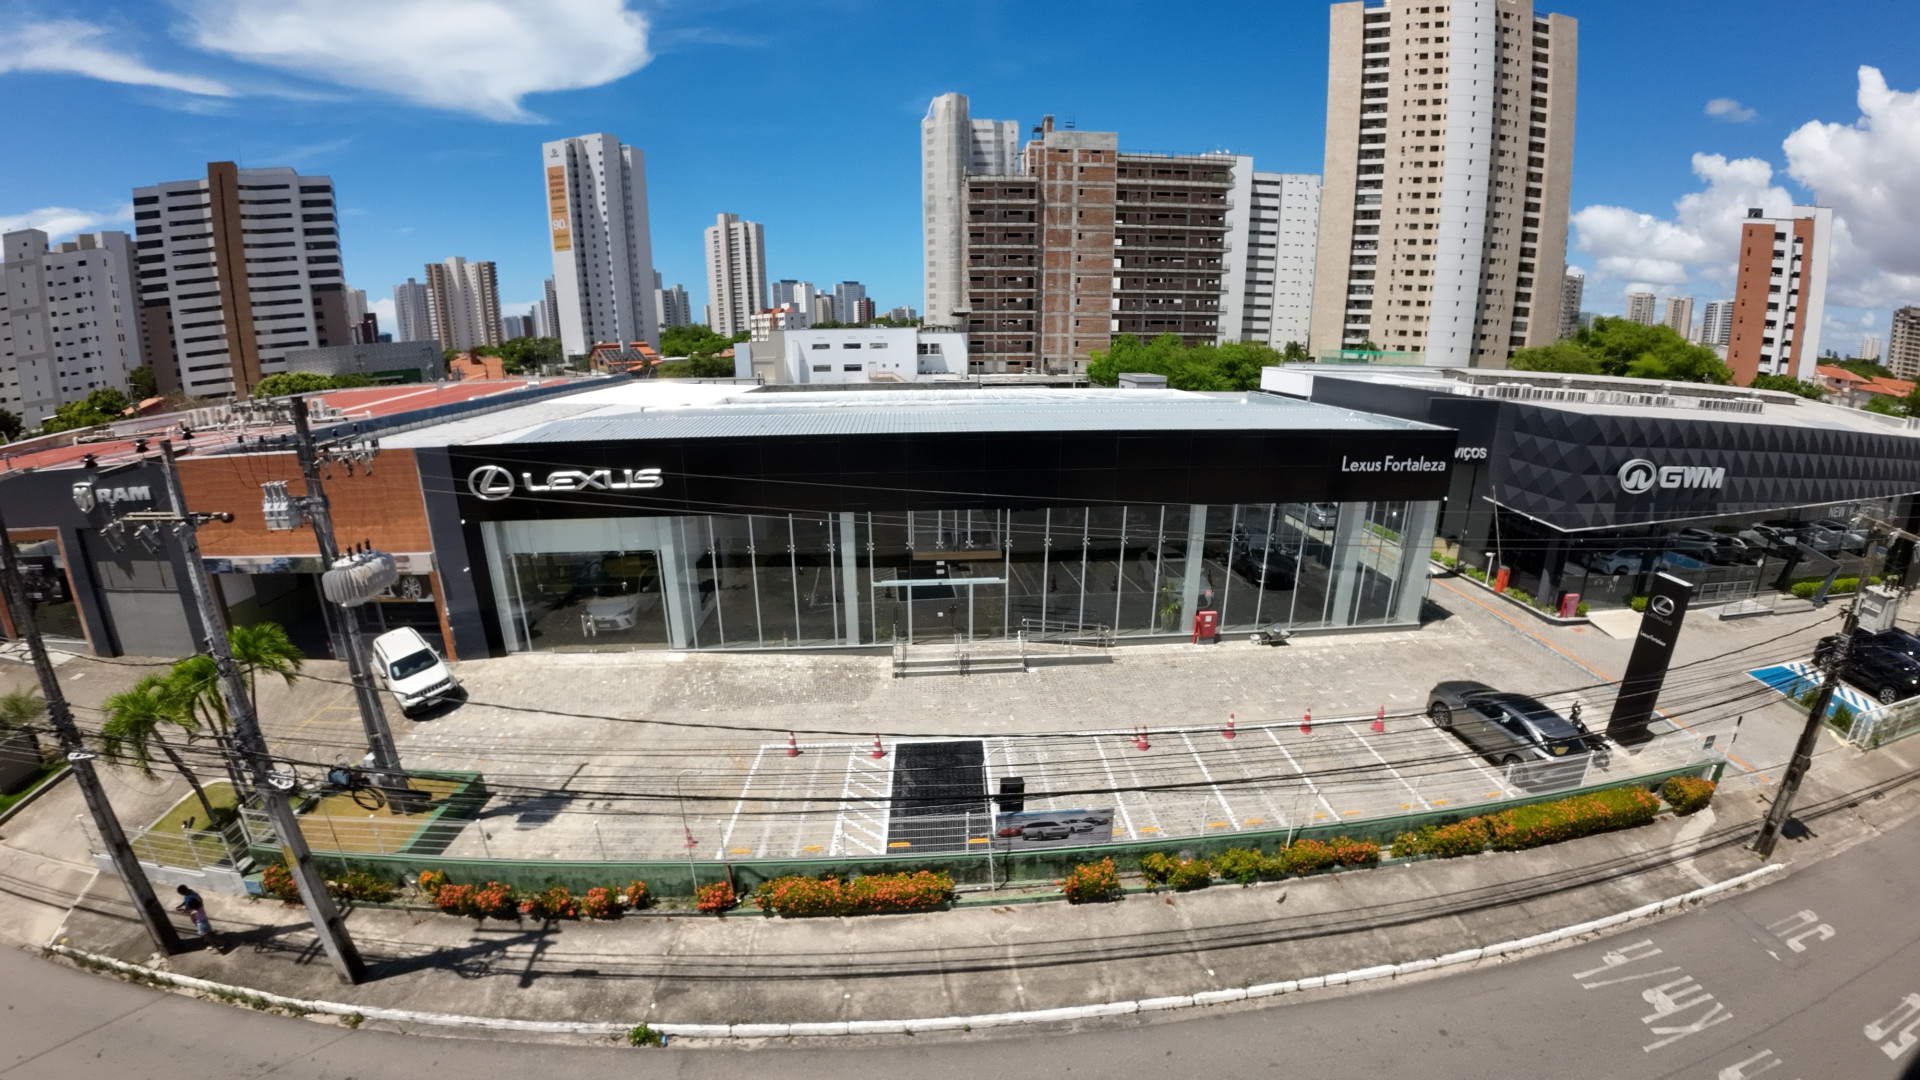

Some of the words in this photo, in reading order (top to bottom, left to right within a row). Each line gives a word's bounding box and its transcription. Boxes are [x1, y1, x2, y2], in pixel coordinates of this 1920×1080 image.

[553, 219, 565, 230] 90
[1341, 455, 1382, 472] Lexus
[1384, 455, 1447, 472] Fortaleza
[521, 468, 664, 492] LEXUS
[1658, 465, 1726, 489] GWM
[95, 486, 152, 503] RAM
